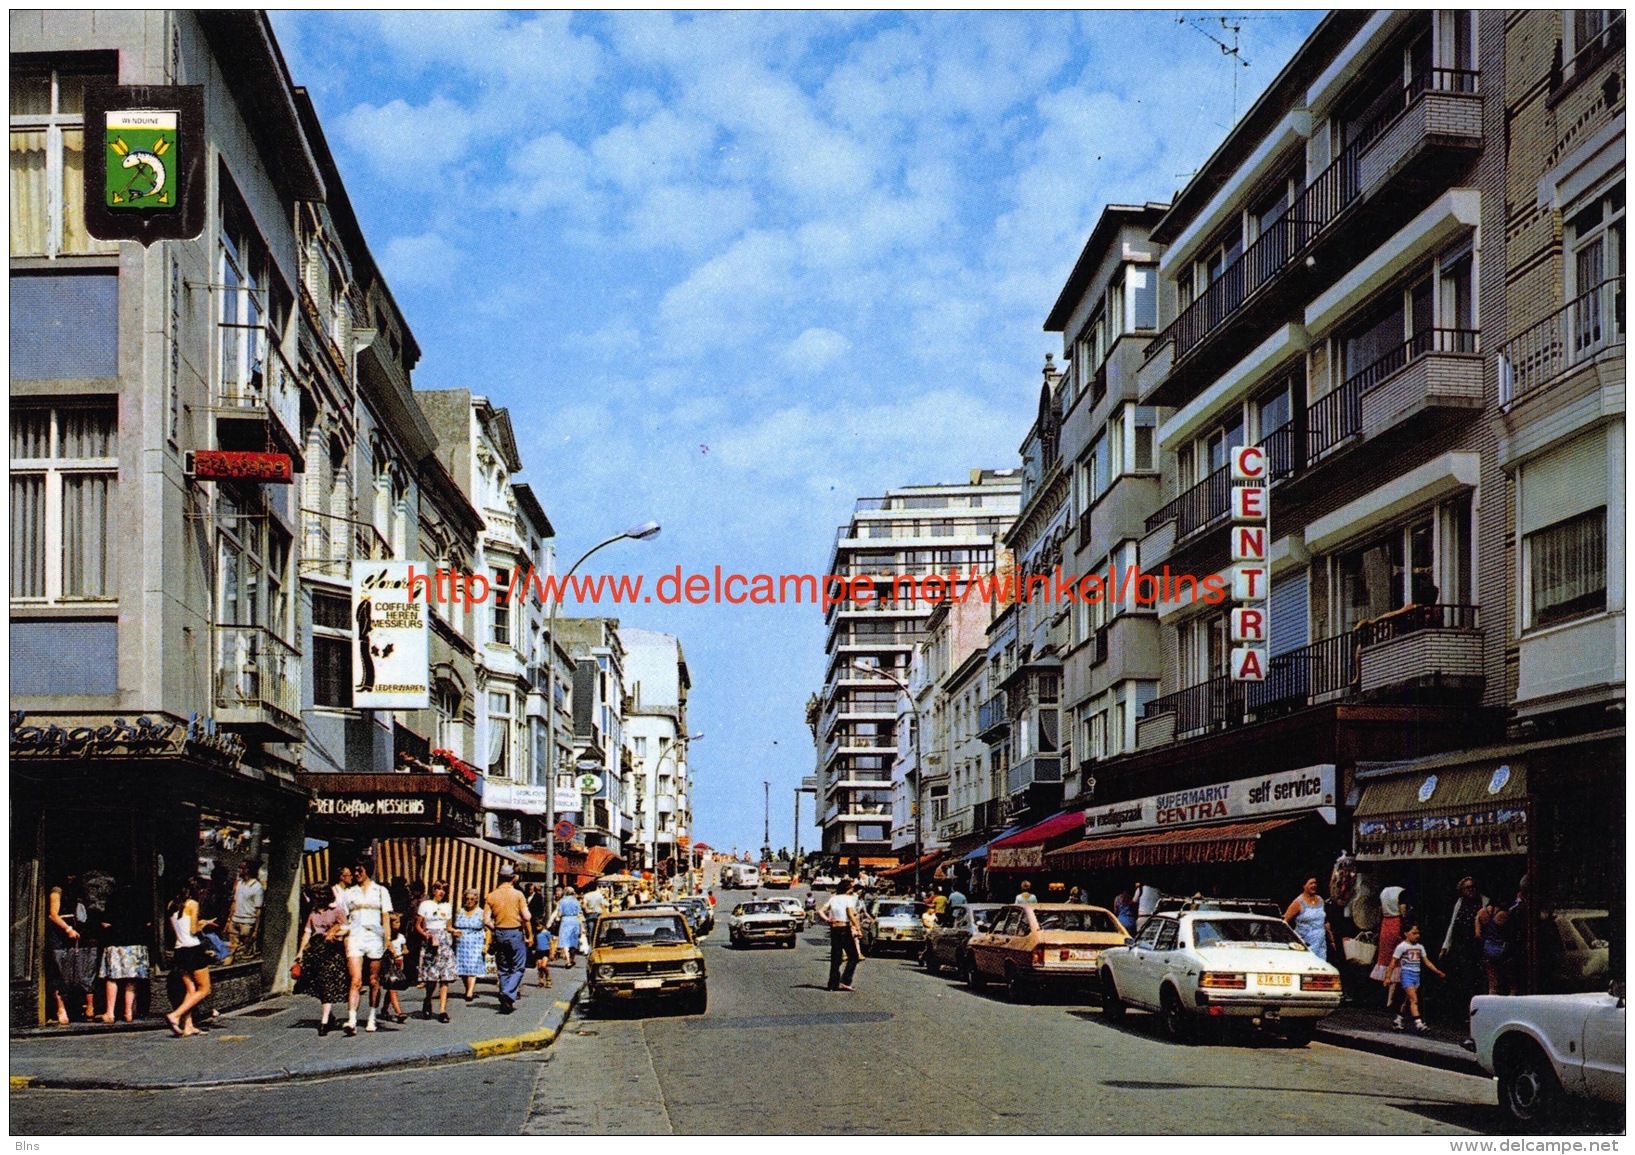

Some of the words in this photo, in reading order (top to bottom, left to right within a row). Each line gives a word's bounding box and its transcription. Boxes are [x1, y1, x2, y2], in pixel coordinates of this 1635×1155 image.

[1238, 447, 1264, 680] CENTRA
[374, 602, 421, 612] COIFFURE
[385, 611, 418, 620] HEREN
[371, 619, 424, 629] MESSIEURS
[374, 684, 426, 693] LEDERWAREN
[1156, 785, 1230, 810] SUPERMARKT
[1249, 781, 1271, 804] self
[1274, 774, 1321, 800] service
[336, 798, 376, 818] Coiffure
[376, 798, 425, 815] MESSIEURS
[1156, 800, 1228, 825] CENTRA
